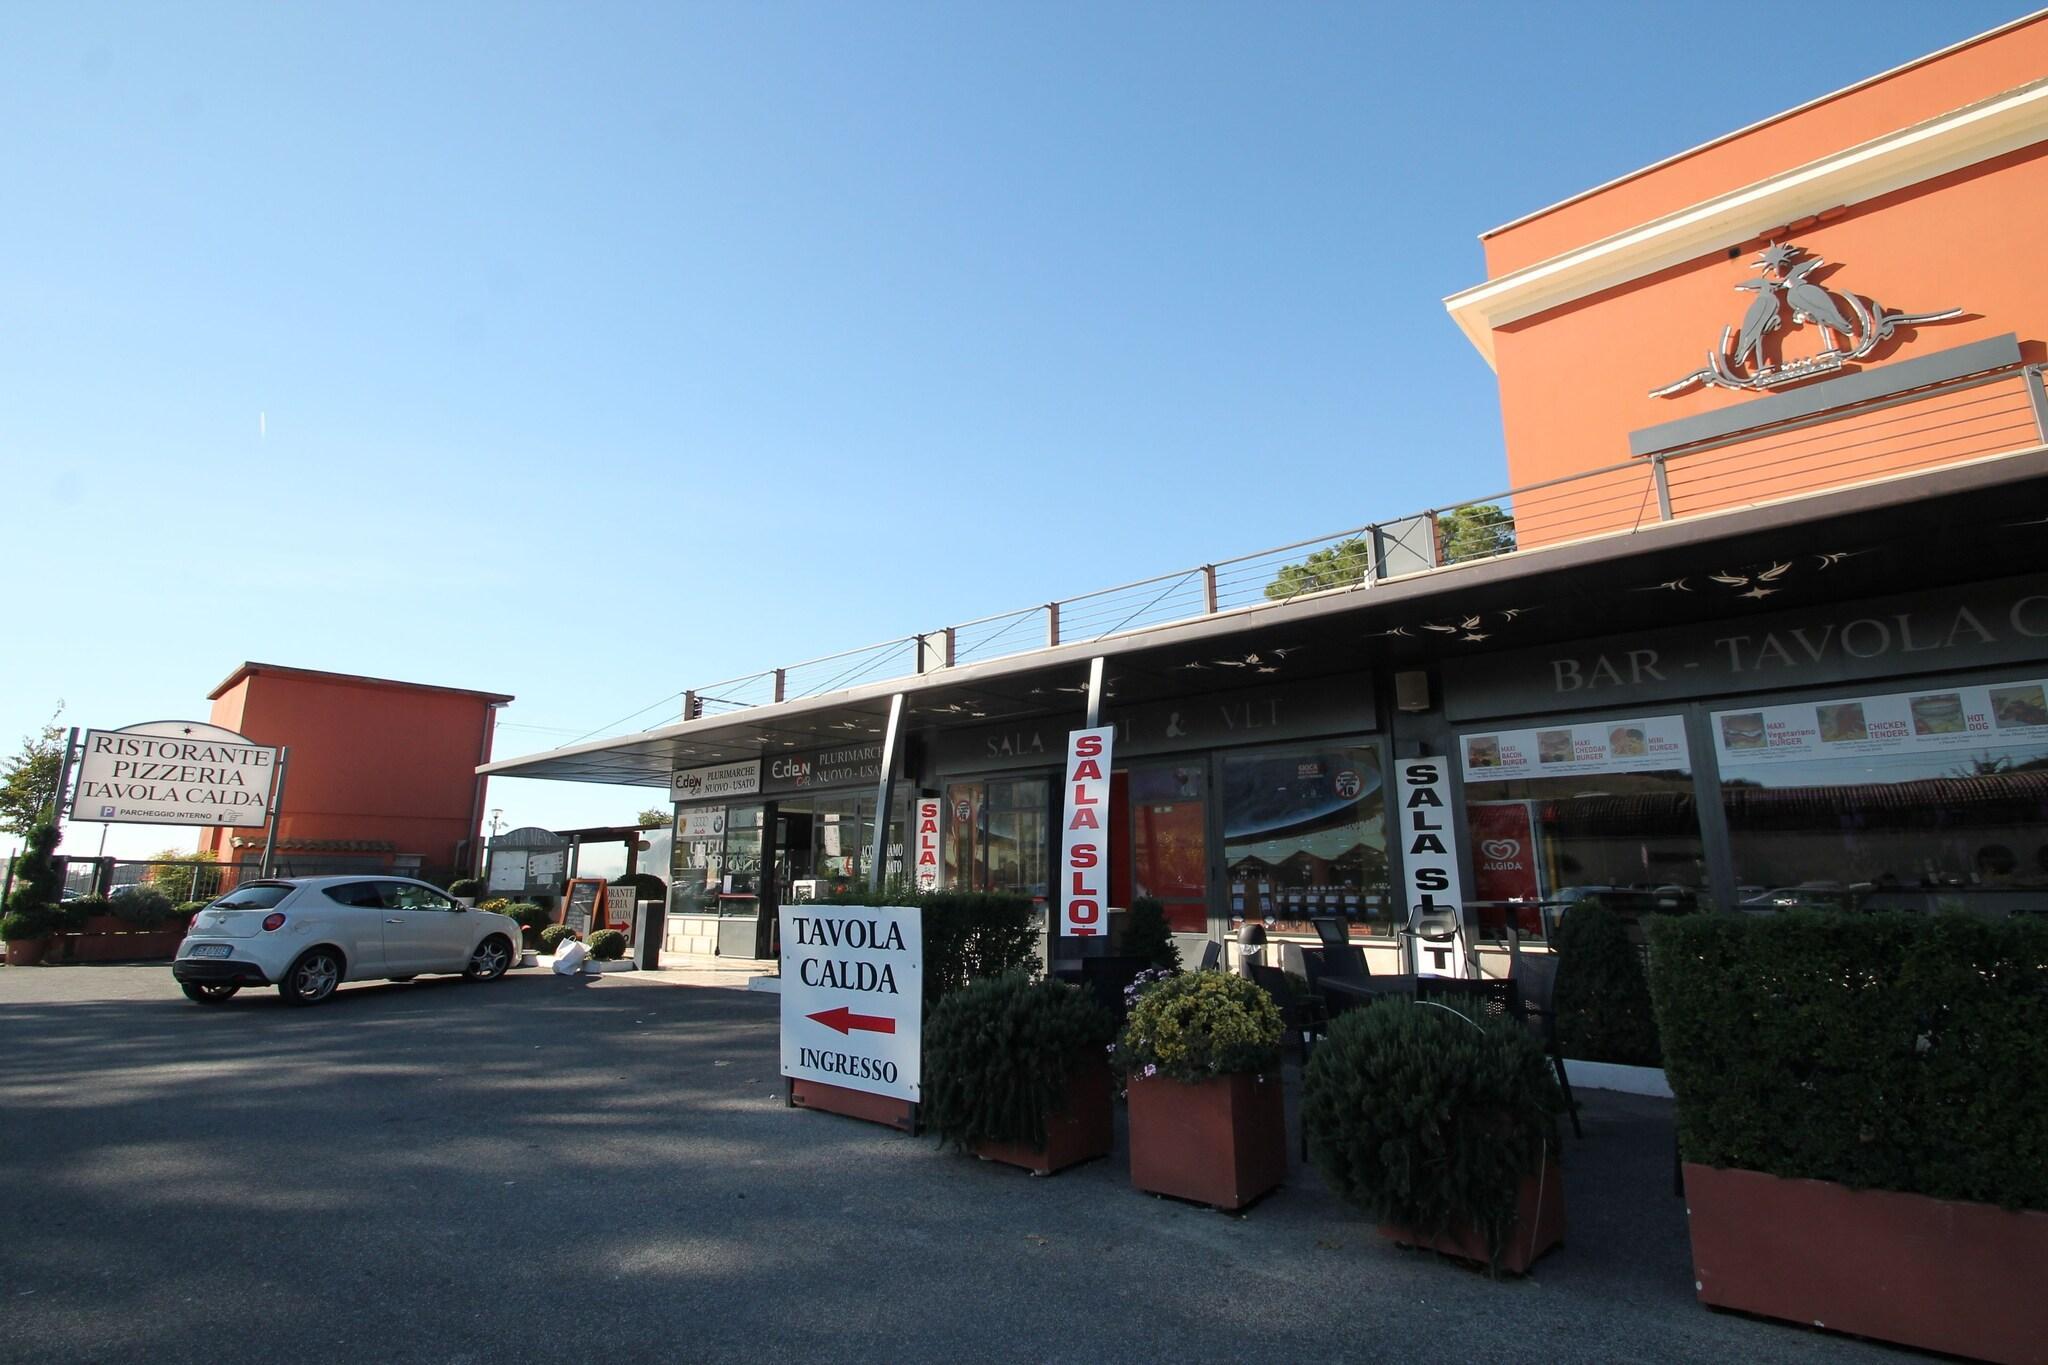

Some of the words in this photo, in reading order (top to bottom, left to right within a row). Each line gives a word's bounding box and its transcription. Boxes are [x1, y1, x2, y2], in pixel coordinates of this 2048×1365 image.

[1552, 648, 1667, 694] BAR
[1714, 604, 1998, 674] TAVOLA
[1868, 721, 1907, 731] CHICKEN
[1967, 714, 1985, 722] HOT
[1968, 722, 1989, 731] DOG
[1768, 738, 1803, 747] BURGER
[1869, 729, 1910, 739] TENDERS
[95, 736, 270, 767] RISTORANTE
[986, 731, 1044, 758] SALA
[1575, 746, 1607, 754] CHEDDAR
[1649, 743, 1679, 752] BURGER
[819, 746, 884, 765] PLURIMARCH
[1576, 752, 1603, 761] BURGER
[112, 760, 246, 786] PIZZERIA
[707, 766, 755, 781] PLURIMARCHE
[816, 767, 852, 782] NUOVO
[860, 764, 881, 778] USA
[704, 782, 728, 793] NUOVO
[733, 779, 755, 790] USATO
[1069, 735, 1102, 830] SALA
[82, 781, 180, 802] TAVOLA
[185, 788, 265, 807] CALDA
[120, 808, 175, 818] PARCHEGGIO
[176, 811, 212, 820] INTERNO
[1406, 764, 1448, 854] SALA
[919, 803, 937, 865] SALA
[1482, 861, 1523, 871] ALGIDA
[793, 917, 906, 951] TAVOLA
[800, 958, 899, 995] CALDA
[799, 1047, 898, 1084] INGRESSO
